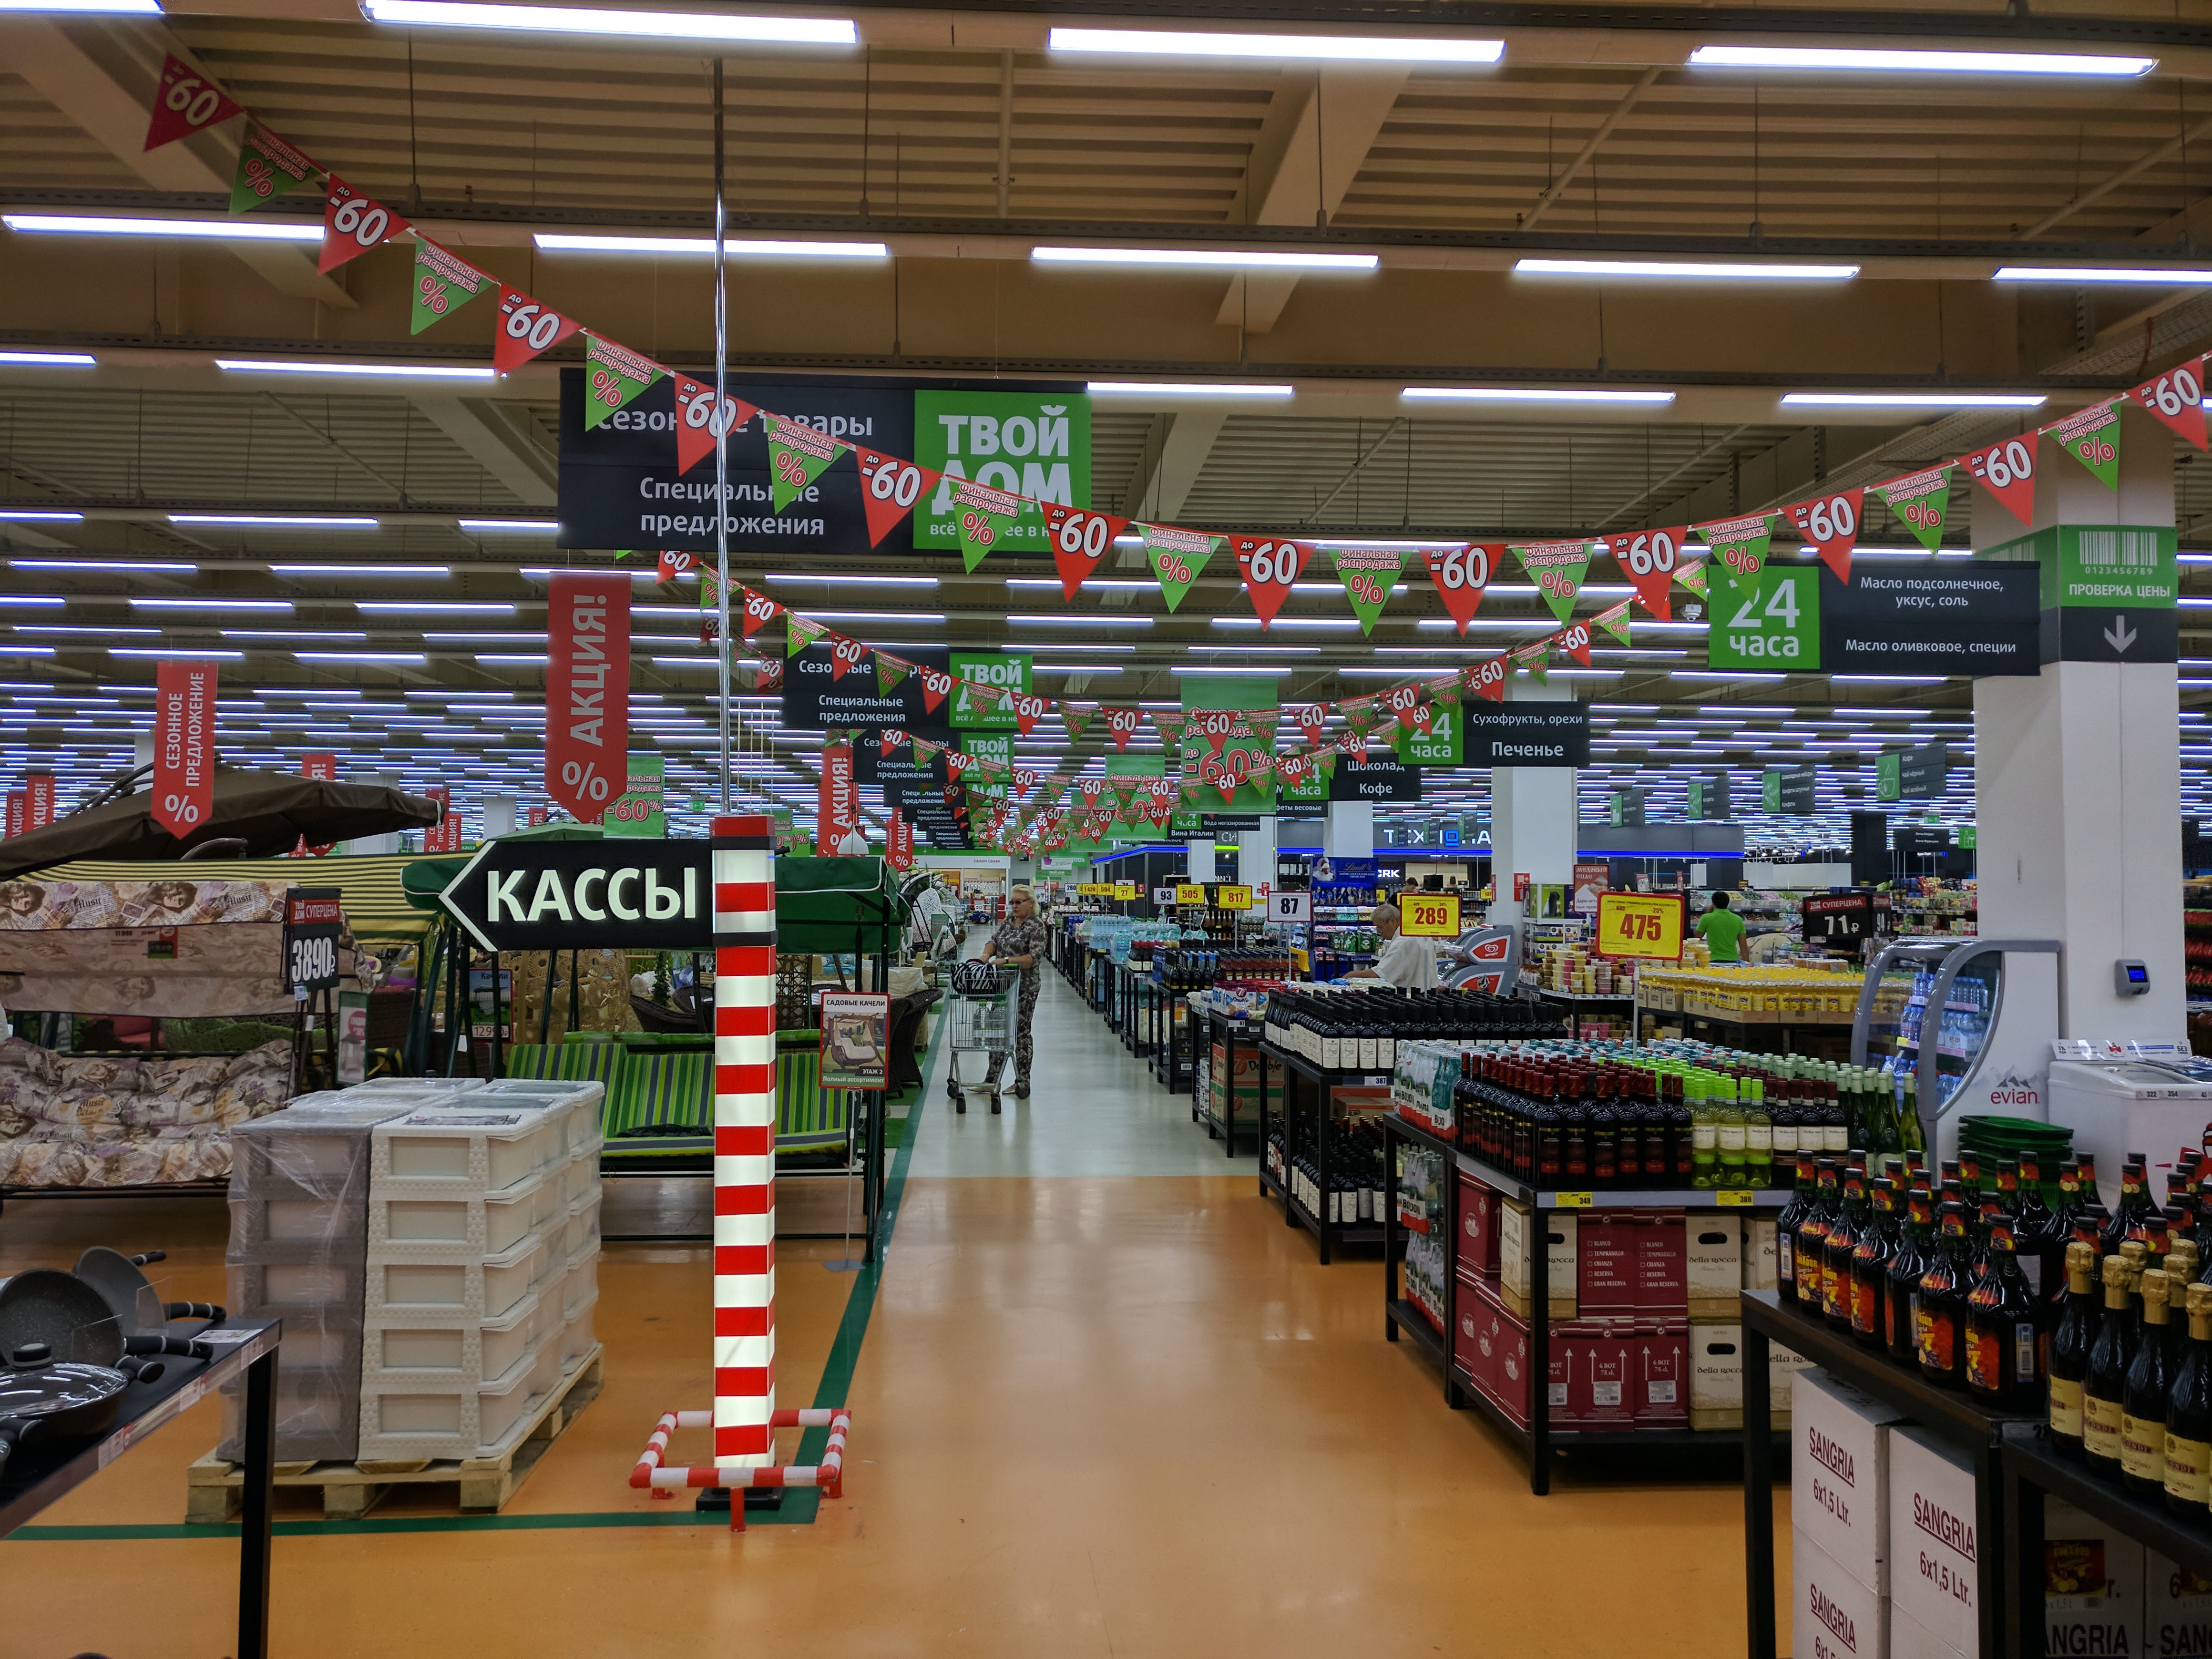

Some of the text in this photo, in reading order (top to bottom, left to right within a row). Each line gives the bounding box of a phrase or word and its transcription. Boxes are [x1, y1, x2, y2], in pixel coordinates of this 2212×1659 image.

[164, 73, 219, 125] -60
[337, 186, 350, 196] до
[329, 196, 389, 247] -60
[416, 252, 478, 294] распродажа
[508, 294, 522, 303] до
[501, 303, 560, 349] -60
[588, 348, 650, 385] распродажа
[684, 383, 696, 392] до
[2147, 369, 2201, 417] -60
[678, 391, 737, 437] -60
[939, 405, 1069, 456] ТВОЙ
[769, 431, 833, 461] распродажа
[866, 455, 879, 464] до
[1975, 440, 2032, 488] -60
[862, 461, 921, 507] -60
[1887, 478, 1947, 506] распродажа
[953, 492, 1017, 517] распродажа
[1052, 510, 1065, 518] до
[930, 523, 955, 536] всё
[1798, 496, 1854, 542] -60
[1050, 512, 1107, 558] -60
[1145, 537, 1210, 554] распродажа
[1707, 526, 1769, 547] распродажа
[1241, 542, 1253, 550] до
[1431, 549, 1443, 558] до
[1617, 532, 1674, 575] -60
[1239, 542, 1297, 585] -60
[1337, 558, 1401, 571] распродажа
[1431, 547, 1488, 589] -60
[1524, 553, 1587, 568] распродажа
[1861, 577, 2003, 592] Масло подсолнечное,
[2069, 584, 2170, 598] ПРОВЕРКА ЦЕНЫ
[746, 596, 775, 621] -60
[1895, 595, 1968, 608] уксус, соль
[832, 640, 861, 663] -60
[1730, 635, 1799, 657] часа
[1846, 639, 2016, 654] Масло оливковое, специи
[570, 594, 611, 747] АКЦИЯ!
[799, 660, 871, 674] Сезоые
[960, 659, 1022, 684] ТВОЙ
[922, 672, 952, 695] -60
[819, 695, 903, 707] Специальные
[957, 685, 1022, 711] ДМ
[1014, 696, 1043, 718] -60
[819, 712, 905, 723] предложения
[1107, 711, 1136, 731] -60
[1473, 713, 1583, 726] Сухофрукты, орехи
[166, 693, 183, 769] СЕЗОННОЕ
[186, 672, 204, 787] ПРЕДЛОЖЕНИЕ
[968, 737, 1008, 753] ТВОЙ
[1185, 748, 1199, 758] до
[1411, 745, 1452, 758] часа
[1492, 741, 1563, 757] Печенье
[877, 760, 932, 769] Специальые
[1348, 760, 1404, 772] Шоколад
[1291, 786, 1321, 795] часа
[1360, 782, 1393, 796] Кофе
[33, 783, 48, 830] КЦИЯ!
[12, 799, 24, 837] КЦИЯ!
[487, 867, 696, 922] КАССЫ
[1160, 891, 1172, 900] 93
[1182, 890, 1198, 899] 505
[1228, 893, 1244, 902] 817
[1823, 899, 1862, 908] СУПЕРЦЕНА
[306, 904, 338, 919] СУПЕРЦЕНА
[1281, 898, 1298, 914] 87
[1415, 908, 1447, 924] 289
[1620, 913, 1661, 941] 475
[1824, 915, 1848, 935] 71
[1990, 1089, 2038, 1104] evian
[1810, 1427, 1854, 1484] SANGRIA
[1837, 1495, 1851, 1527] Ltr.
[1914, 1493, 1976, 1558] SANGRIA
[1953, 1571, 1971, 1607] Ltr.
[1811, 1584, 1856, 1649] SANGRIA
[2045, 1625, 2129, 1655] NGRIA
